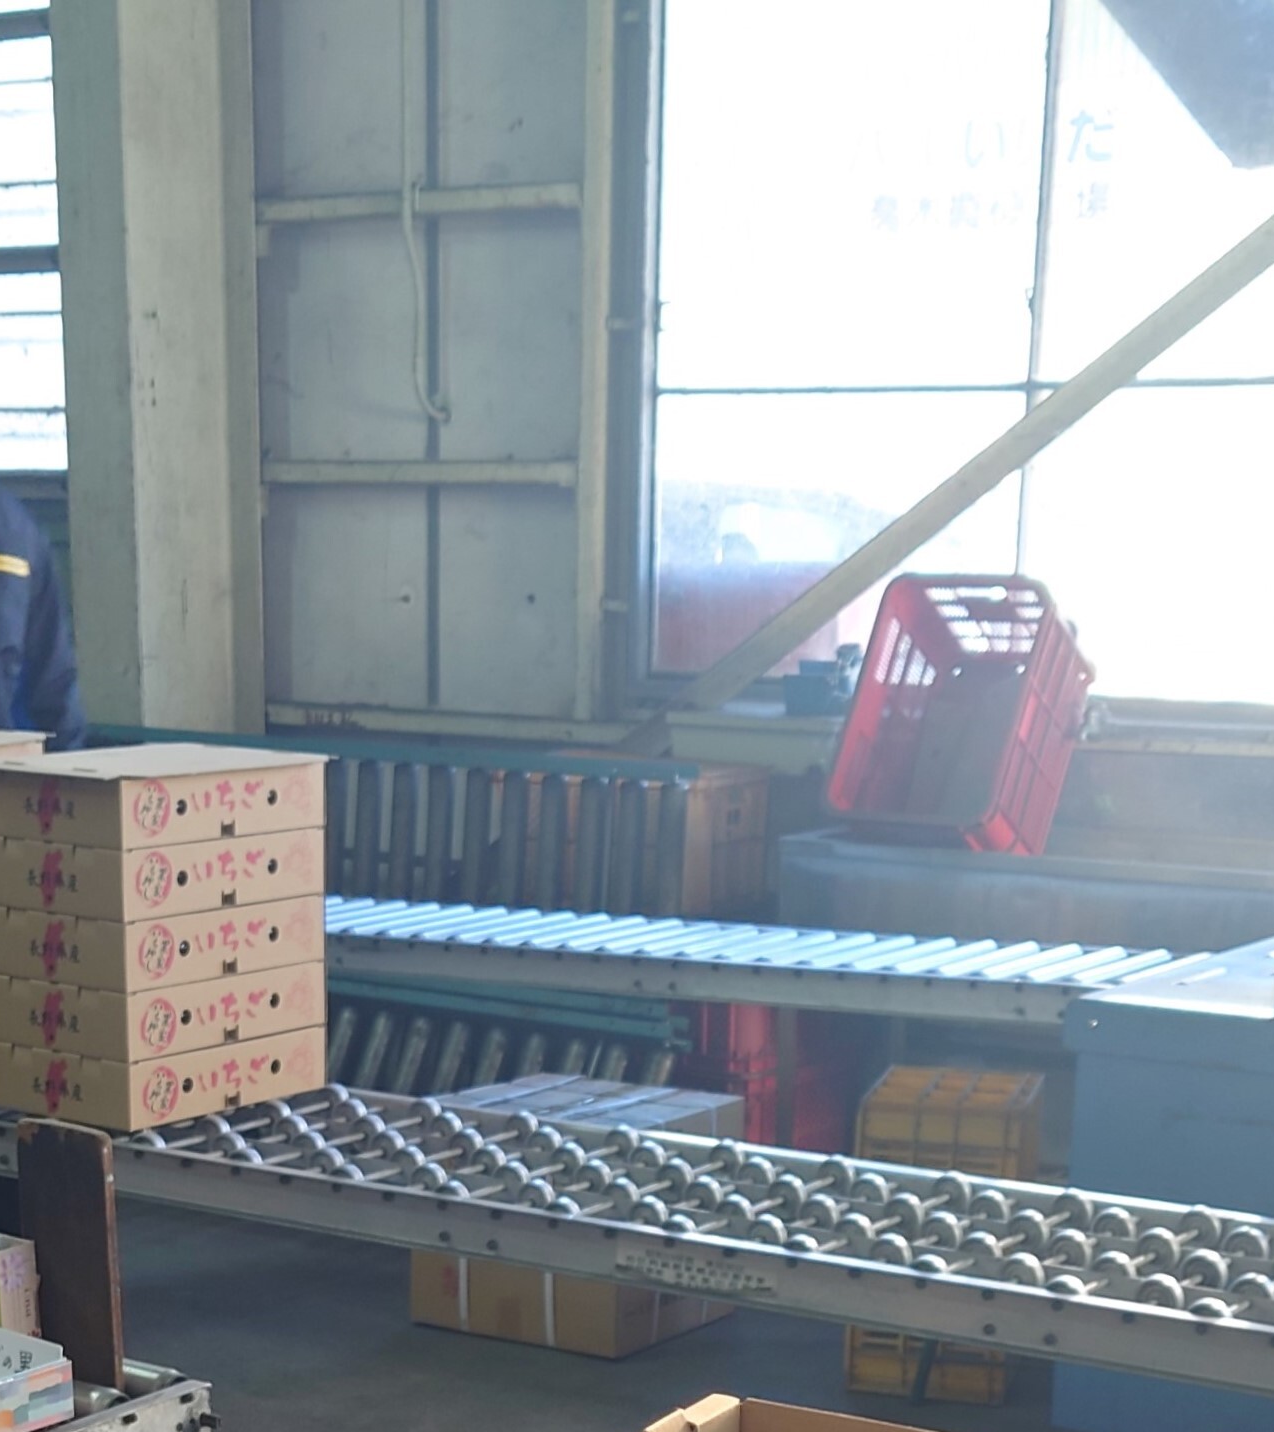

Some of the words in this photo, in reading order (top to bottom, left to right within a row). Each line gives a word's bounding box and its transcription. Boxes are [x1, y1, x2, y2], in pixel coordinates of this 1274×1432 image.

[192, 779, 264, 813] いちご
[194, 849, 265, 882] いちご
[195, 918, 267, 952] いちご
[197, 988, 268, 1025] いちご
[199, 1055, 269, 1092] いちご
